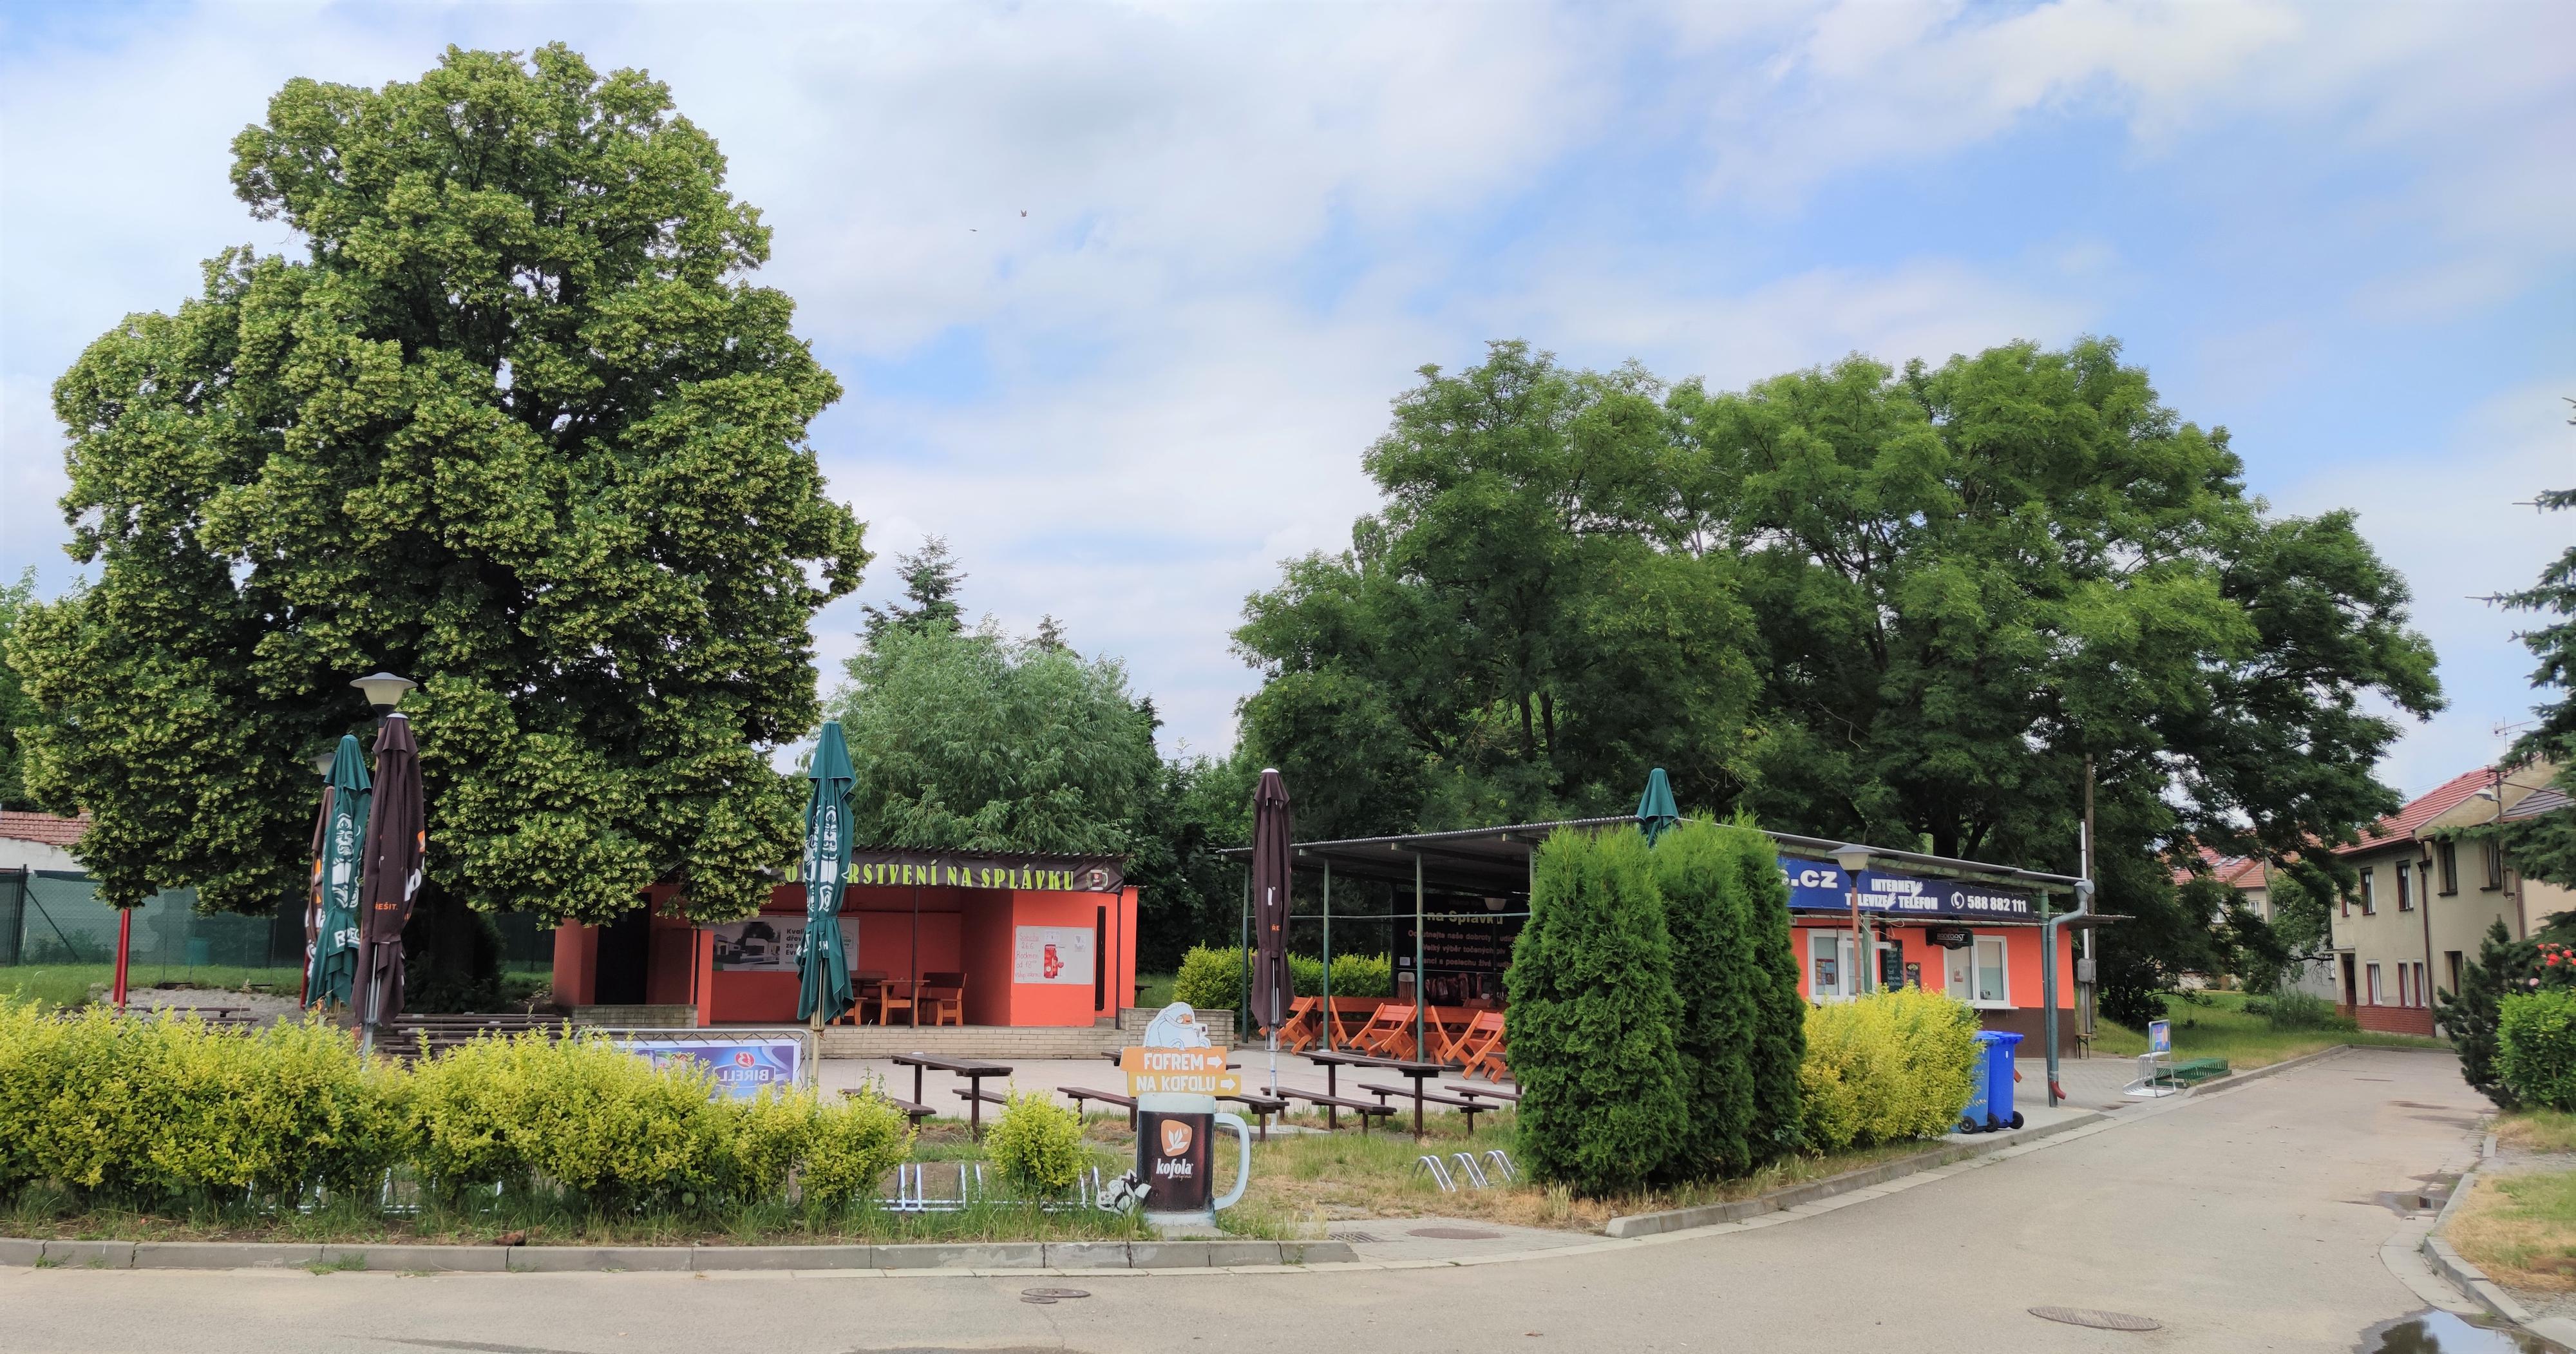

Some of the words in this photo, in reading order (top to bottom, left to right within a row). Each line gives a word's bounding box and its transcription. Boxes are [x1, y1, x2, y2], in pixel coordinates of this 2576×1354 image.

[947, 866, 972, 886] NA
[981, 863, 1074, 890] SPLÁVKU
[1871, 878, 1916, 893] INTERNET
[1844, 893, 1888, 908] TLEVIZE
[1898, 896, 1938, 910] TELEFON
[1967, 895, 1988, 910] 588
[1990, 897, 2011, 911] 882
[2011, 899, 2027, 913] 111
[1465, 933, 1492, 942] dobroty
[1143, 1053, 1204, 1071] FOFREM
[1136, 1076, 1157, 1091] NA
[1161, 1076, 1216, 1092] KOFOLU
[1155, 1158, 1193, 1179] kofola
